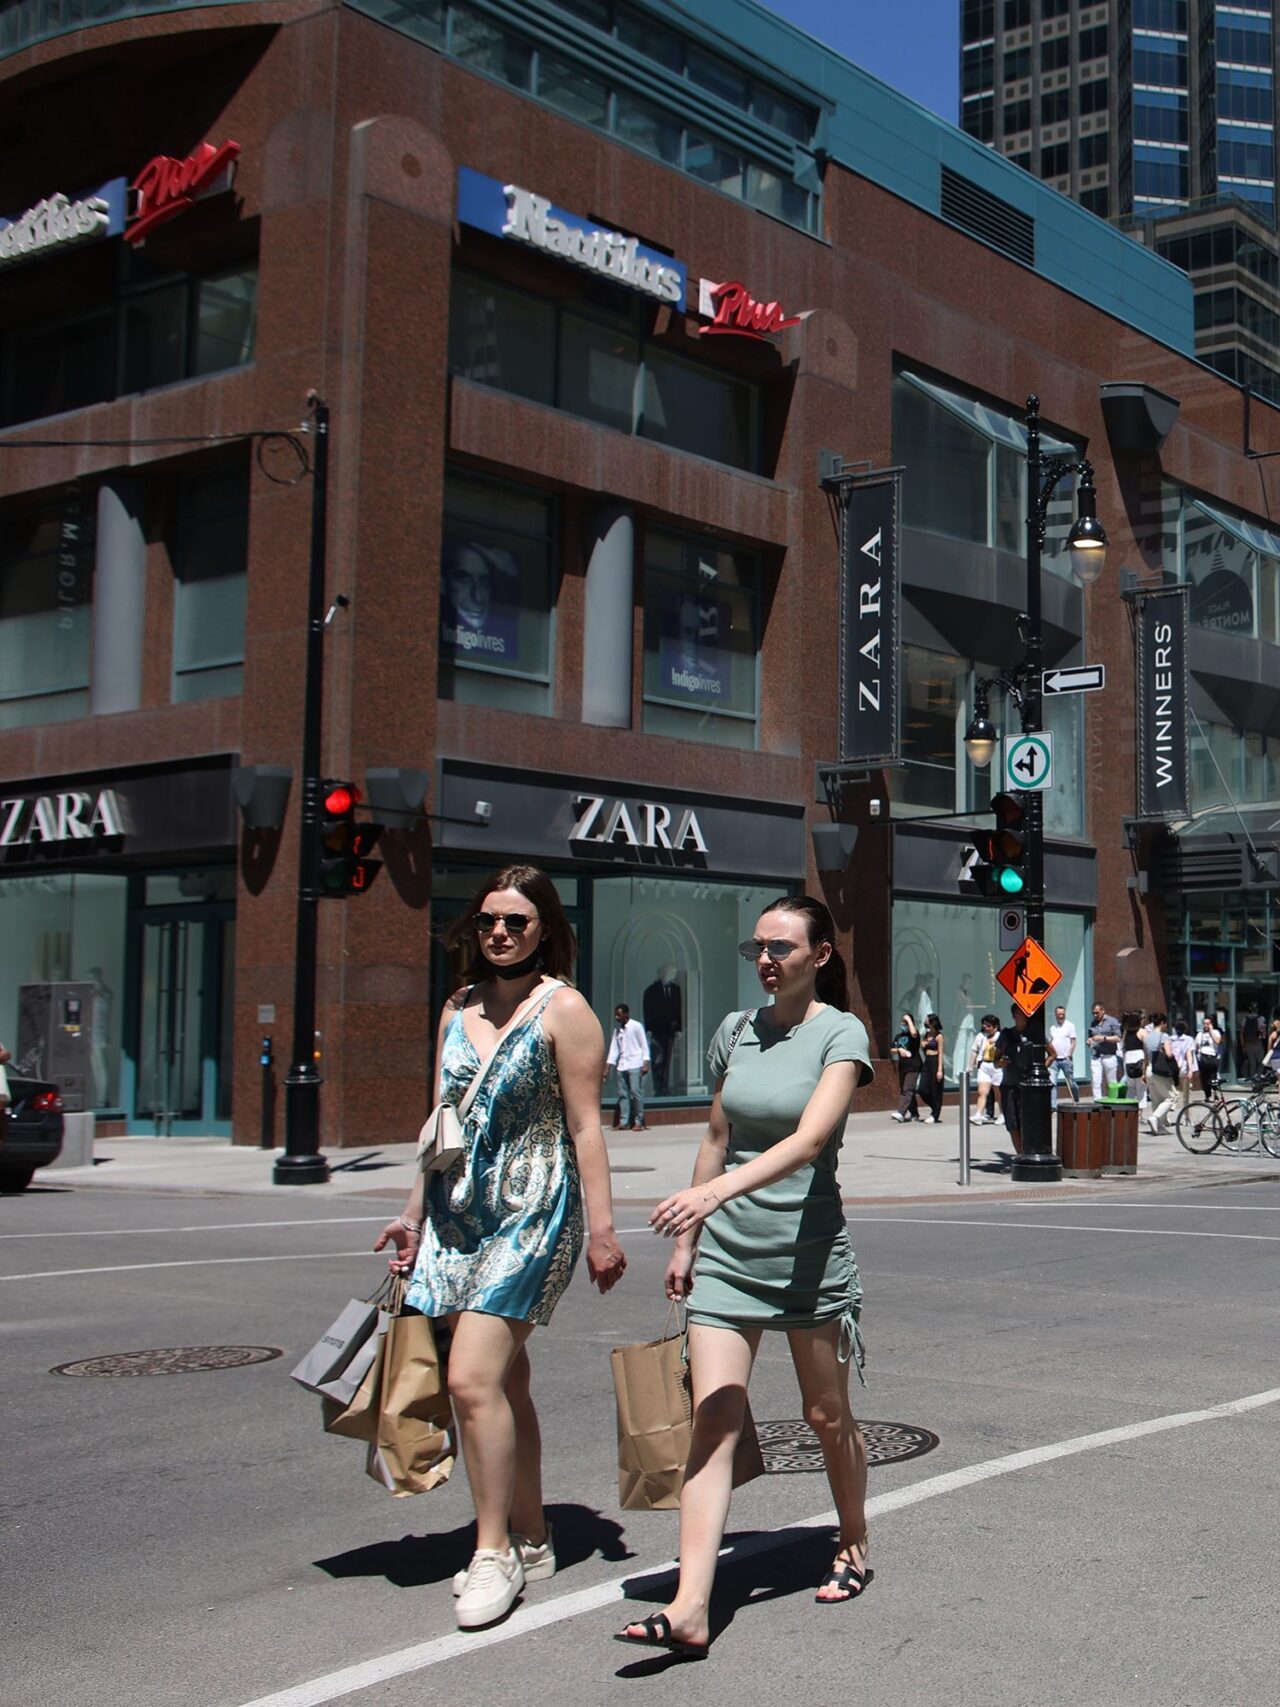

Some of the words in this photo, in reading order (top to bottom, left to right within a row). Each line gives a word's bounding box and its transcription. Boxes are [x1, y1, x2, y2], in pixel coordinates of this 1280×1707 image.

[502, 184, 682, 302] Nautilus
[706, 281, 801, 334] Plus
[858, 526, 881, 711] ZARA
[1155, 624, 1173, 788] WINNERS
[0, 789, 125, 846] ZARA
[569, 795, 710, 852] ZARA
